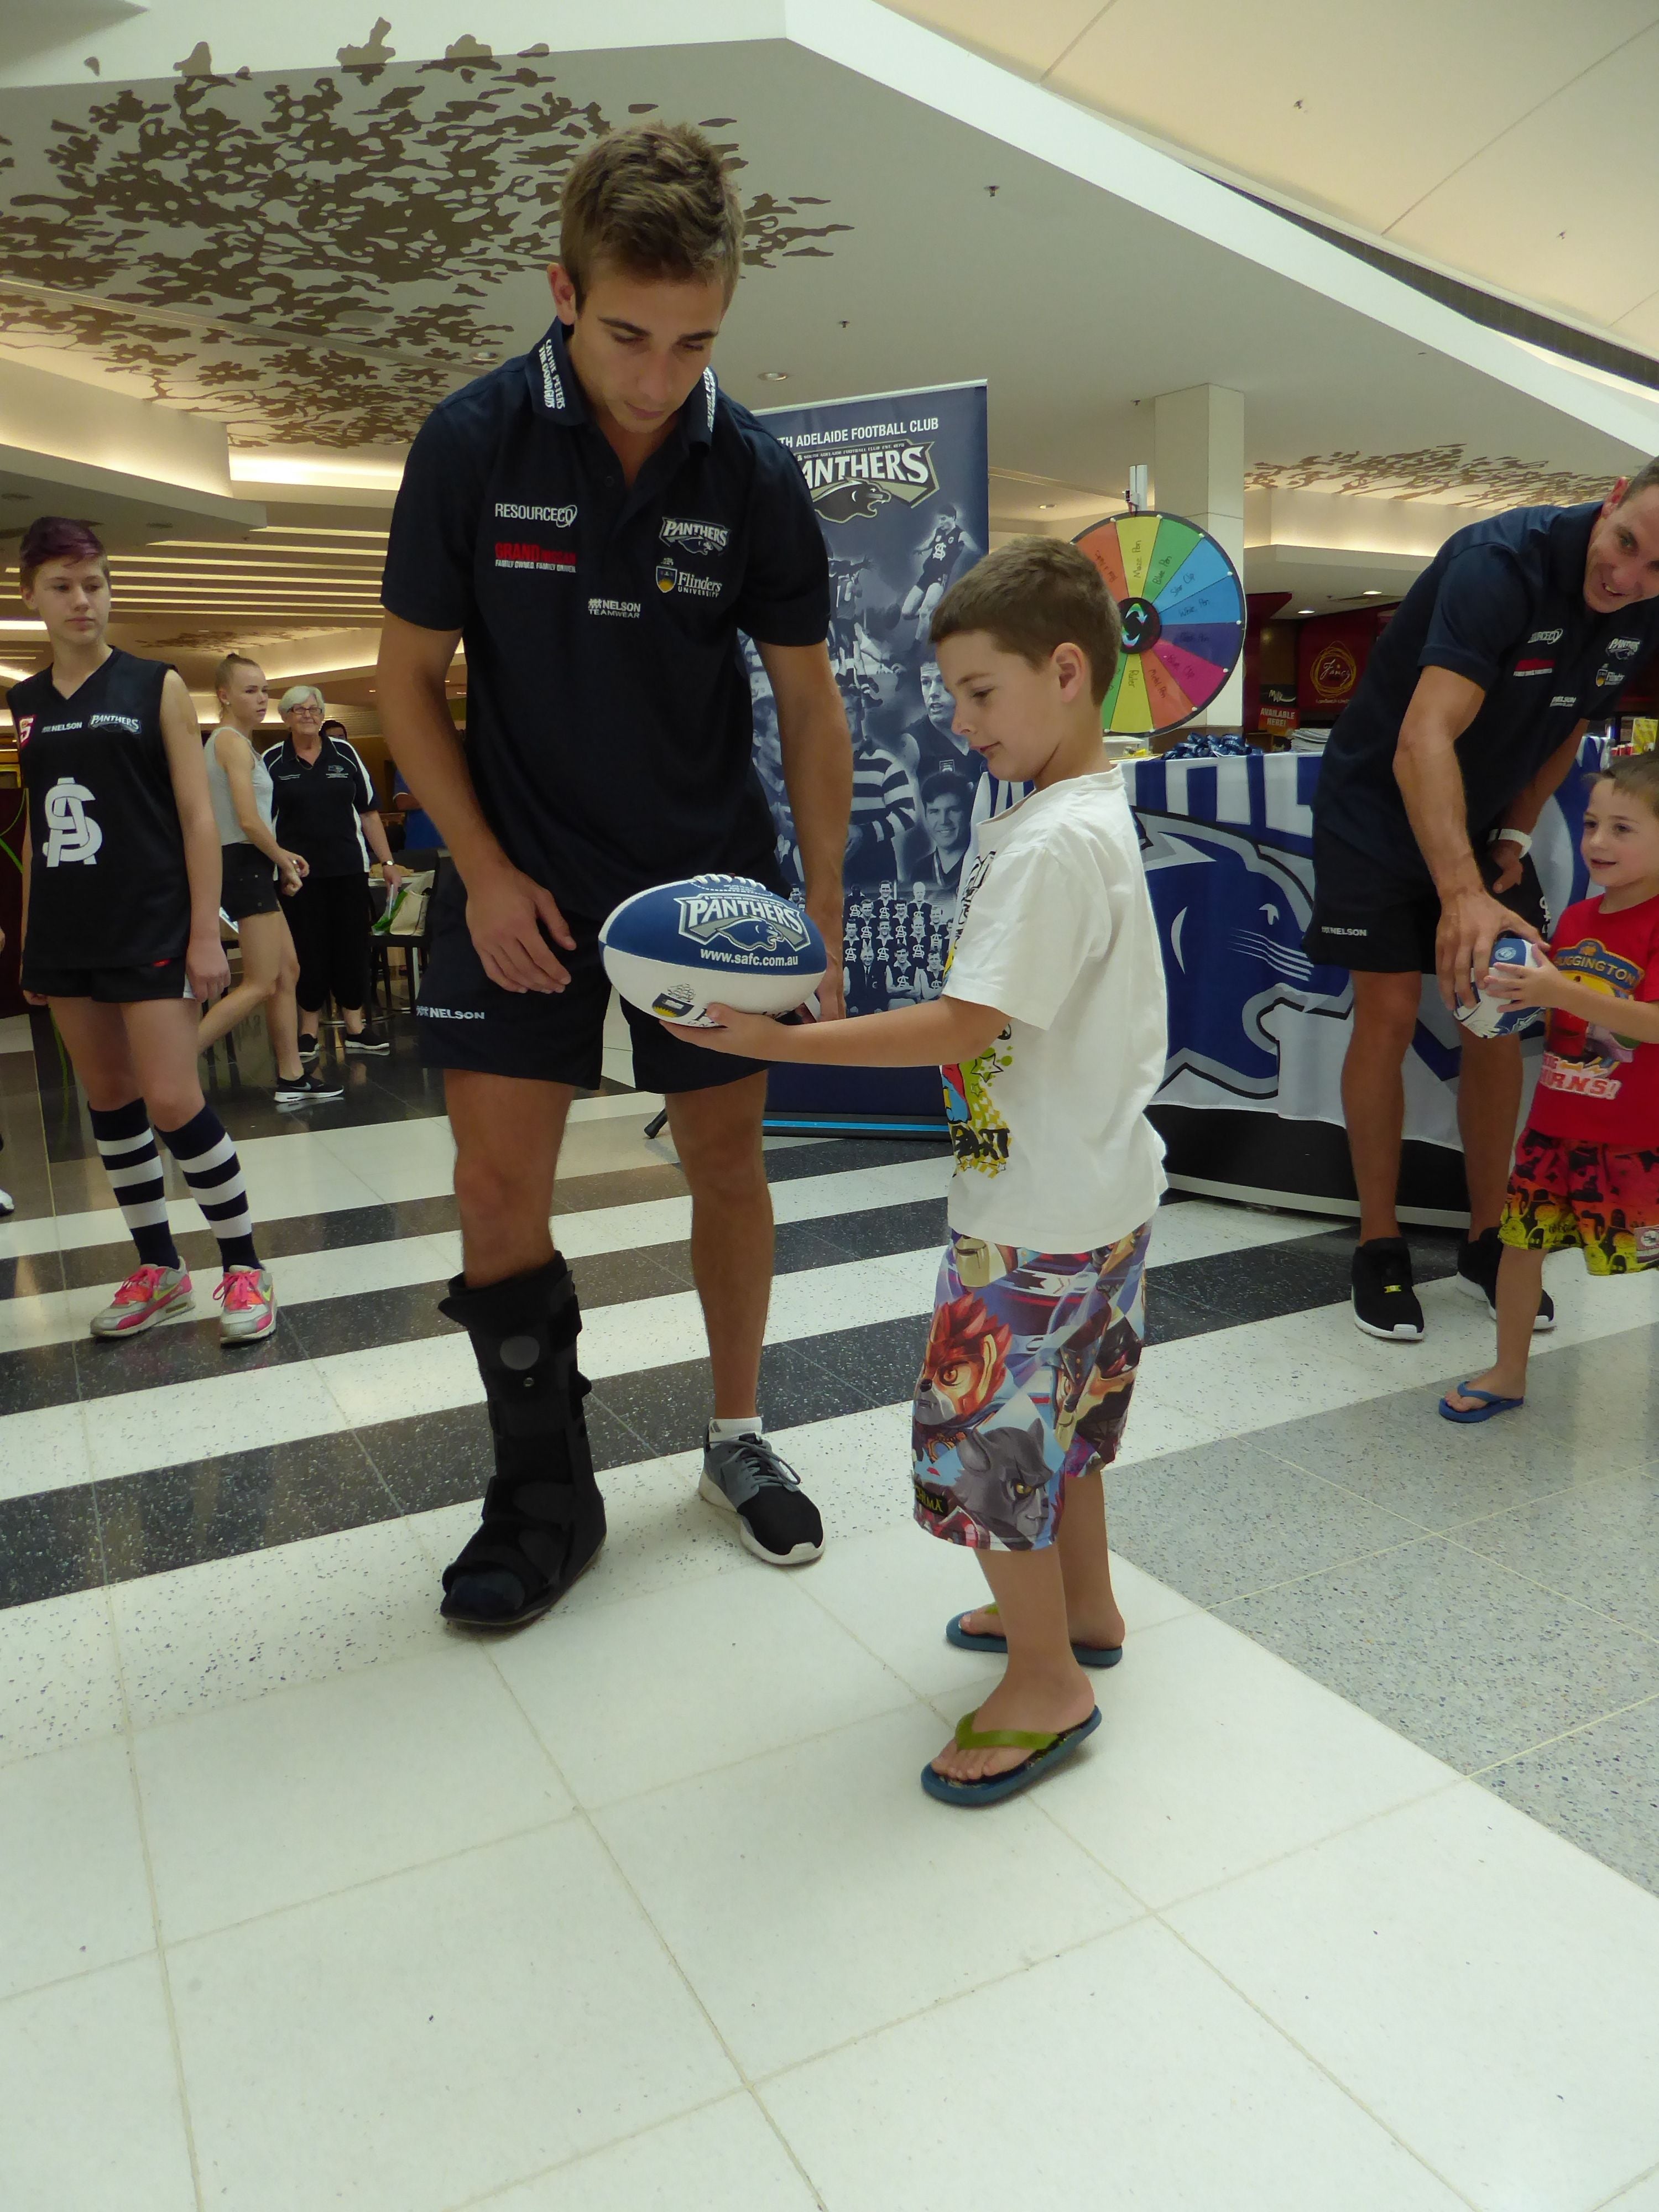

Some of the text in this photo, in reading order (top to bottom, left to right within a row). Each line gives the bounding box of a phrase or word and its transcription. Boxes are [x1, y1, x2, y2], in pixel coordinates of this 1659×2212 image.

[553, 374, 565, 409] PETERS
[776, 418, 938, 448] TH ADELAIDE FOOTBALL CLUB
[802, 446, 928, 489] ANTHERS
[662, 520, 728, 547] PANTHERS
[677, 572, 722, 592] Flinders
[677, 586, 719, 598] UNIVERSITY
[603, 599, 641, 612] NELSON
[588, 609, 640, 618] TEAMWEAR
[1260, 708, 1295, 719] AVAILABLE
[51, 722, 82, 732] NELSON
[90, 715, 139, 730] PANTHERS
[685, 899, 803, 935] PANTHERS
[1330, 927, 1367, 936] NELSON
[701, 949, 798, 967] www.safc.com.au
[430, 1007, 485, 1020] NELSON
